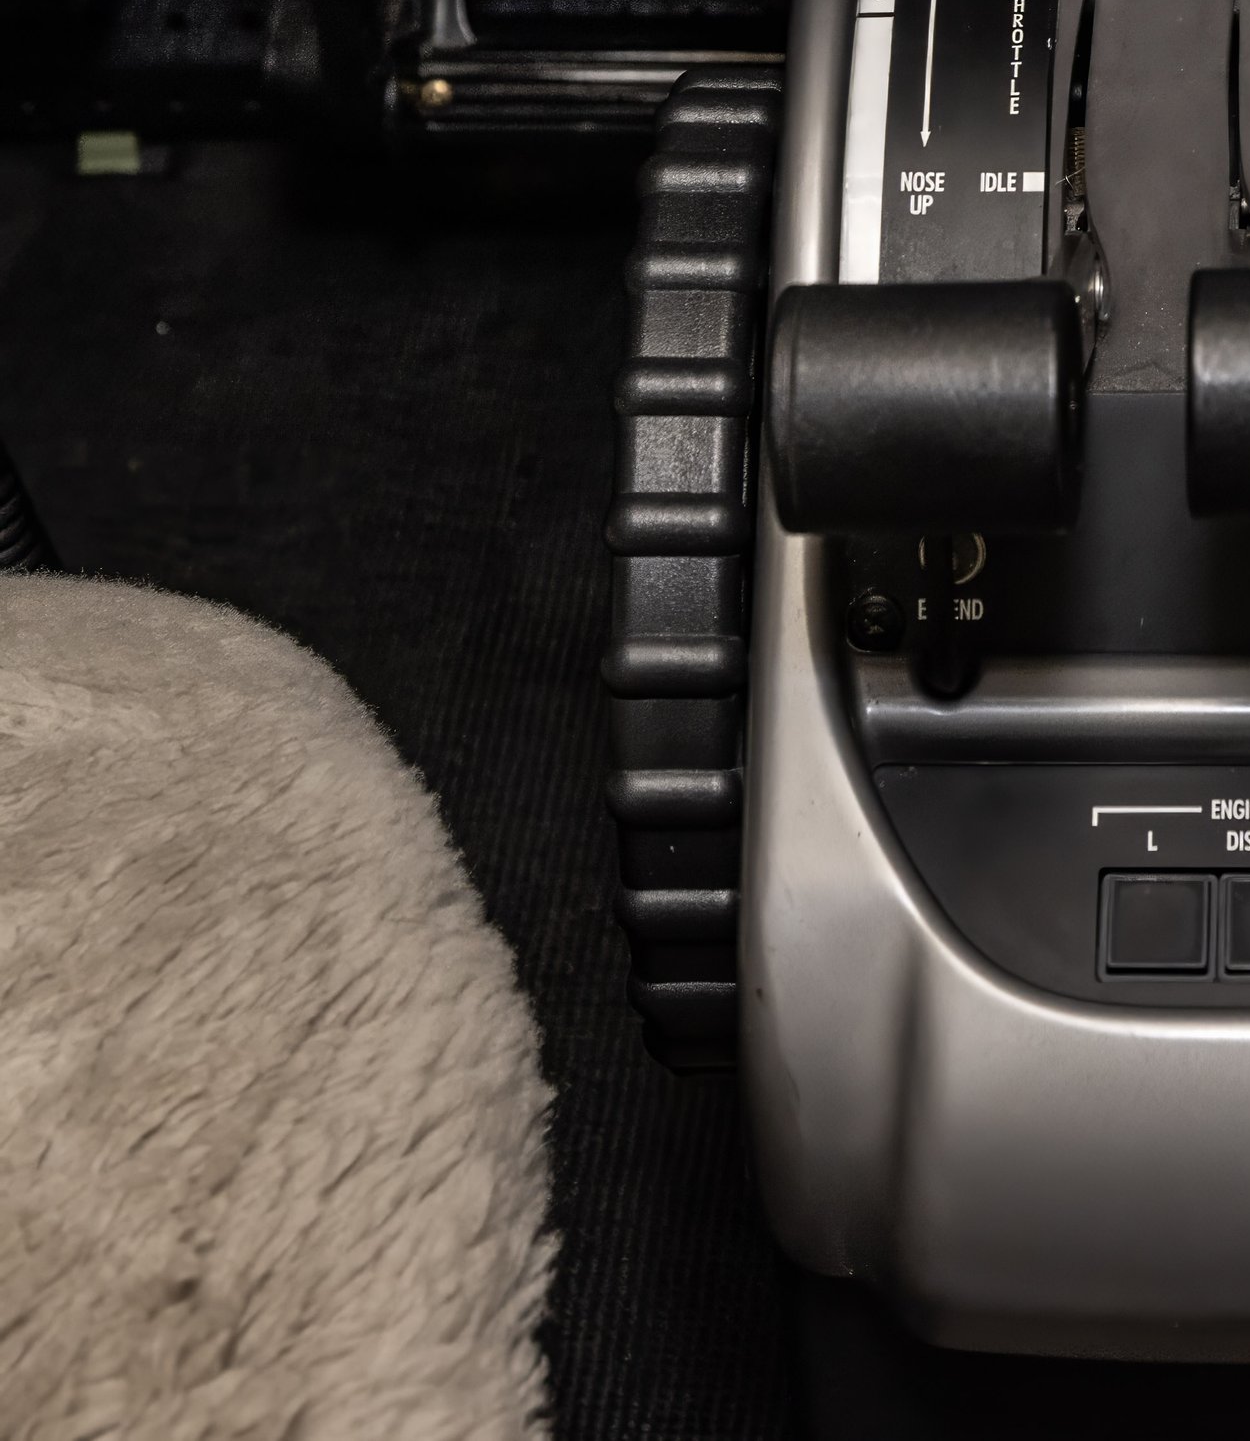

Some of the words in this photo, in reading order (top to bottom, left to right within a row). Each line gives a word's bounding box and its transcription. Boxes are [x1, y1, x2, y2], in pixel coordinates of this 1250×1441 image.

[900, 171, 945, 192] NOSE
[980, 172, 1017, 192] IDLE
[910, 195, 934, 215] UP
[1147, 830, 1158, 852] L
